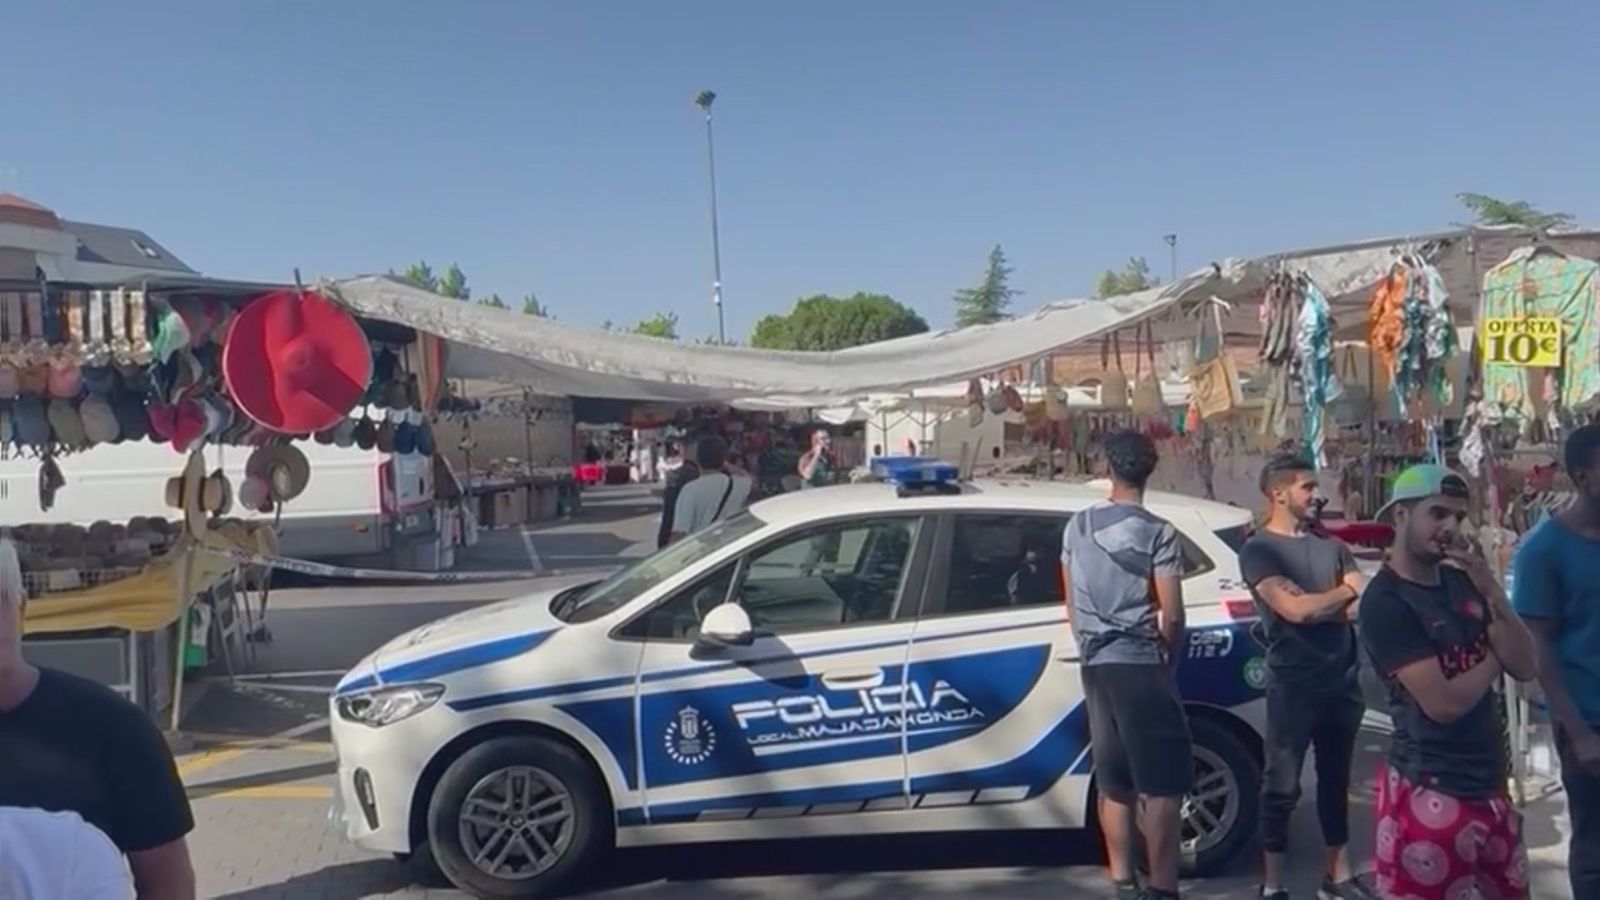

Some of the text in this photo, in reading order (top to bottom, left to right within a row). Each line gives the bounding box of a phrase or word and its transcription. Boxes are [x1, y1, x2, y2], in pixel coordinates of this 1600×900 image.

[1488, 320, 1557, 333] OFERTA
[1487, 333, 1557, 363] 10€
[732, 680, 969, 730] POLICIA
[746, 707, 985, 745] LOCAL MAJADAHONDA
